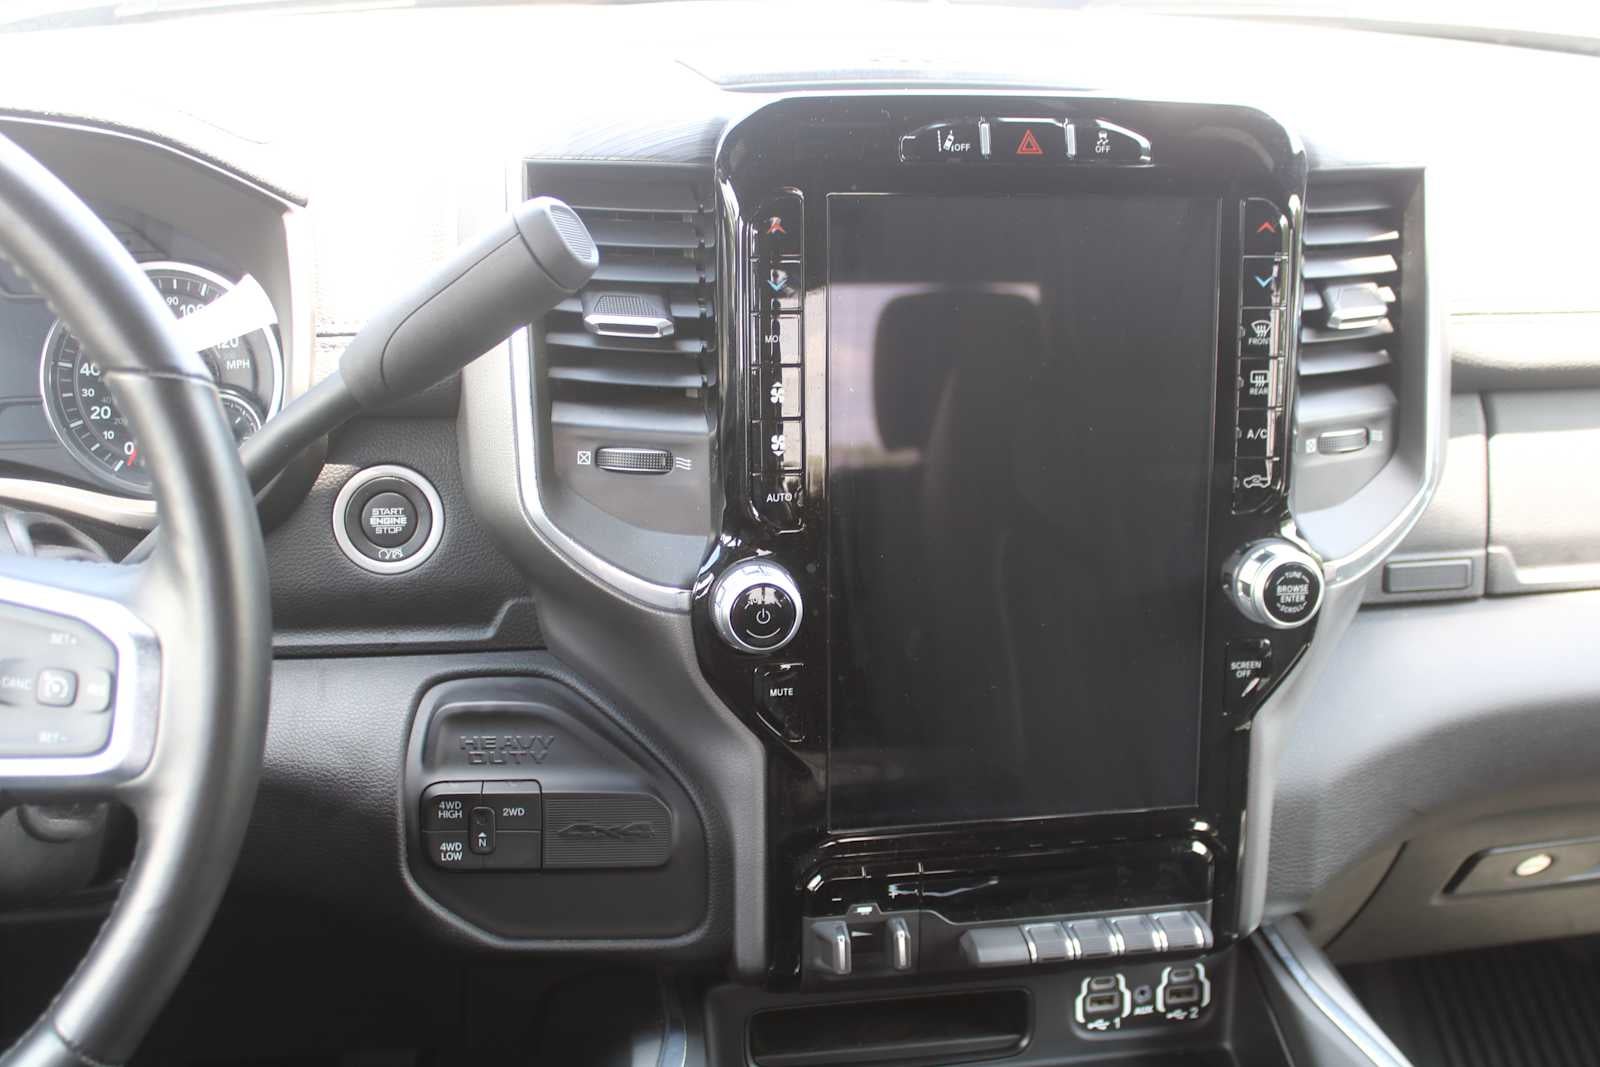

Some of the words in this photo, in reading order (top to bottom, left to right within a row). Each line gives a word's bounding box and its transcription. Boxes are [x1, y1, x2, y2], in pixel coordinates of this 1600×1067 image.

[954, 143, 971, 152] OFF
[1095, 144, 1112, 153] OFF
[166, 296, 179, 305] 90
[226, 359, 250, 370] MPH
[81, 389, 95, 397] 30
[90, 405, 111, 420] 20
[103, 430, 115, 440] 10
[1247, 429, 1268, 439] A/C
[124, 441, 134, 455] 0
[766, 493, 793, 503] AUTO
[371, 507, 404, 515] START
[370, 517, 407, 525] ENGINE
[1276, 584, 1309, 593] BROWSE
[1280, 594, 1306, 603] ENTER
[1230, 660, 1262, 671] SCREEN
[1236, 670, 1251, 678] OFF
[769, 688, 794, 697] MUTE
[460, 735, 555, 750] HEAVY
[467, 750, 554, 765] DUTY
[439, 801, 462, 810] 4WD
[438, 809, 463, 819] HIGH
[503, 807, 525, 817] 2WD
[440, 842, 463, 851] 4WD
[477, 838, 487, 848] N
[441, 852, 463, 861] LOW
[1189, 1007, 1200, 1019] 2
[1113, 1016, 1121, 1029] 1
